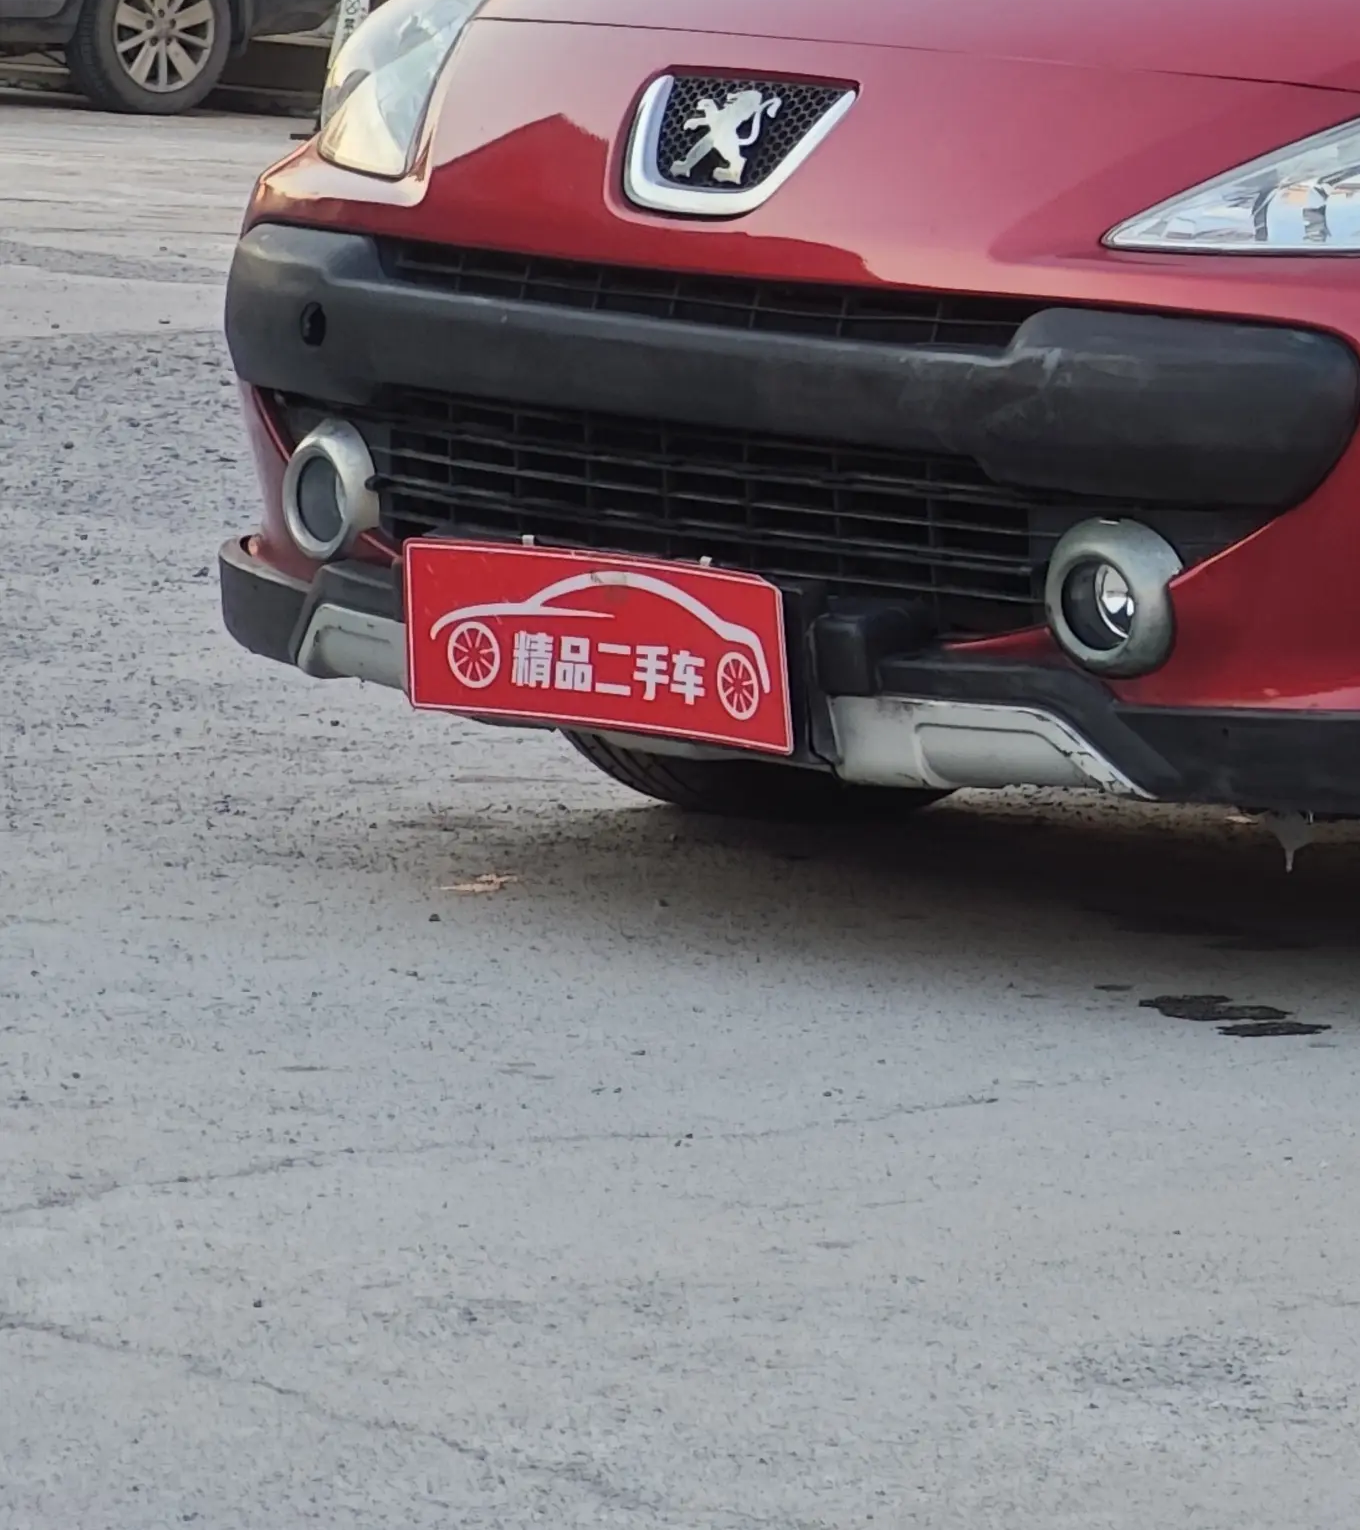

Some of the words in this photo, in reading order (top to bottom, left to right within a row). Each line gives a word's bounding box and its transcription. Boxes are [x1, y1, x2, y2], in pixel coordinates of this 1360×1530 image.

[512, 630, 705, 706] 精品二手车
